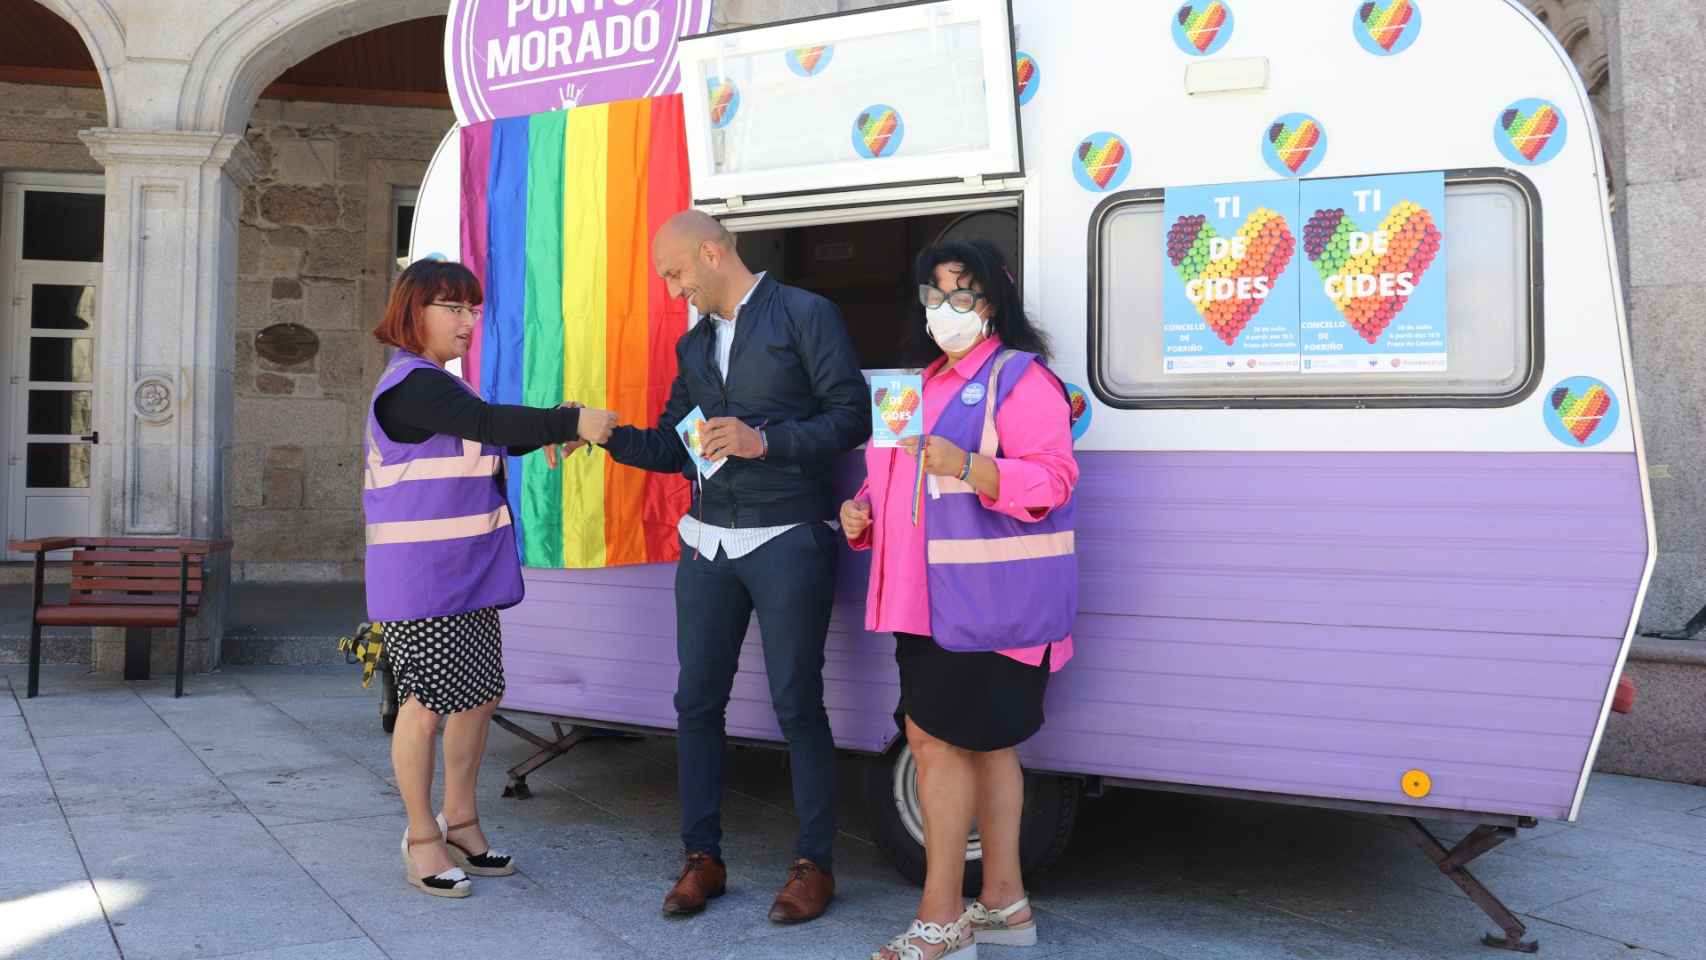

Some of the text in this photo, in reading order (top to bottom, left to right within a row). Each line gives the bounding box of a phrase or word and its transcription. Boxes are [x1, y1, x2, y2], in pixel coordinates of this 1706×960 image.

[487, 8, 660, 80] MORADO
[1213, 196, 1240, 219] TI
[1353, 189, 1381, 213] TI
[1209, 236, 1248, 260] DE
[1349, 231, 1389, 256] DE
[1185, 275, 1269, 302] CIDES
[1324, 272, 1414, 298] CIDES
[1163, 322, 1206, 332] CONCELLO
[1300, 320, 1346, 330] CONCELLO
